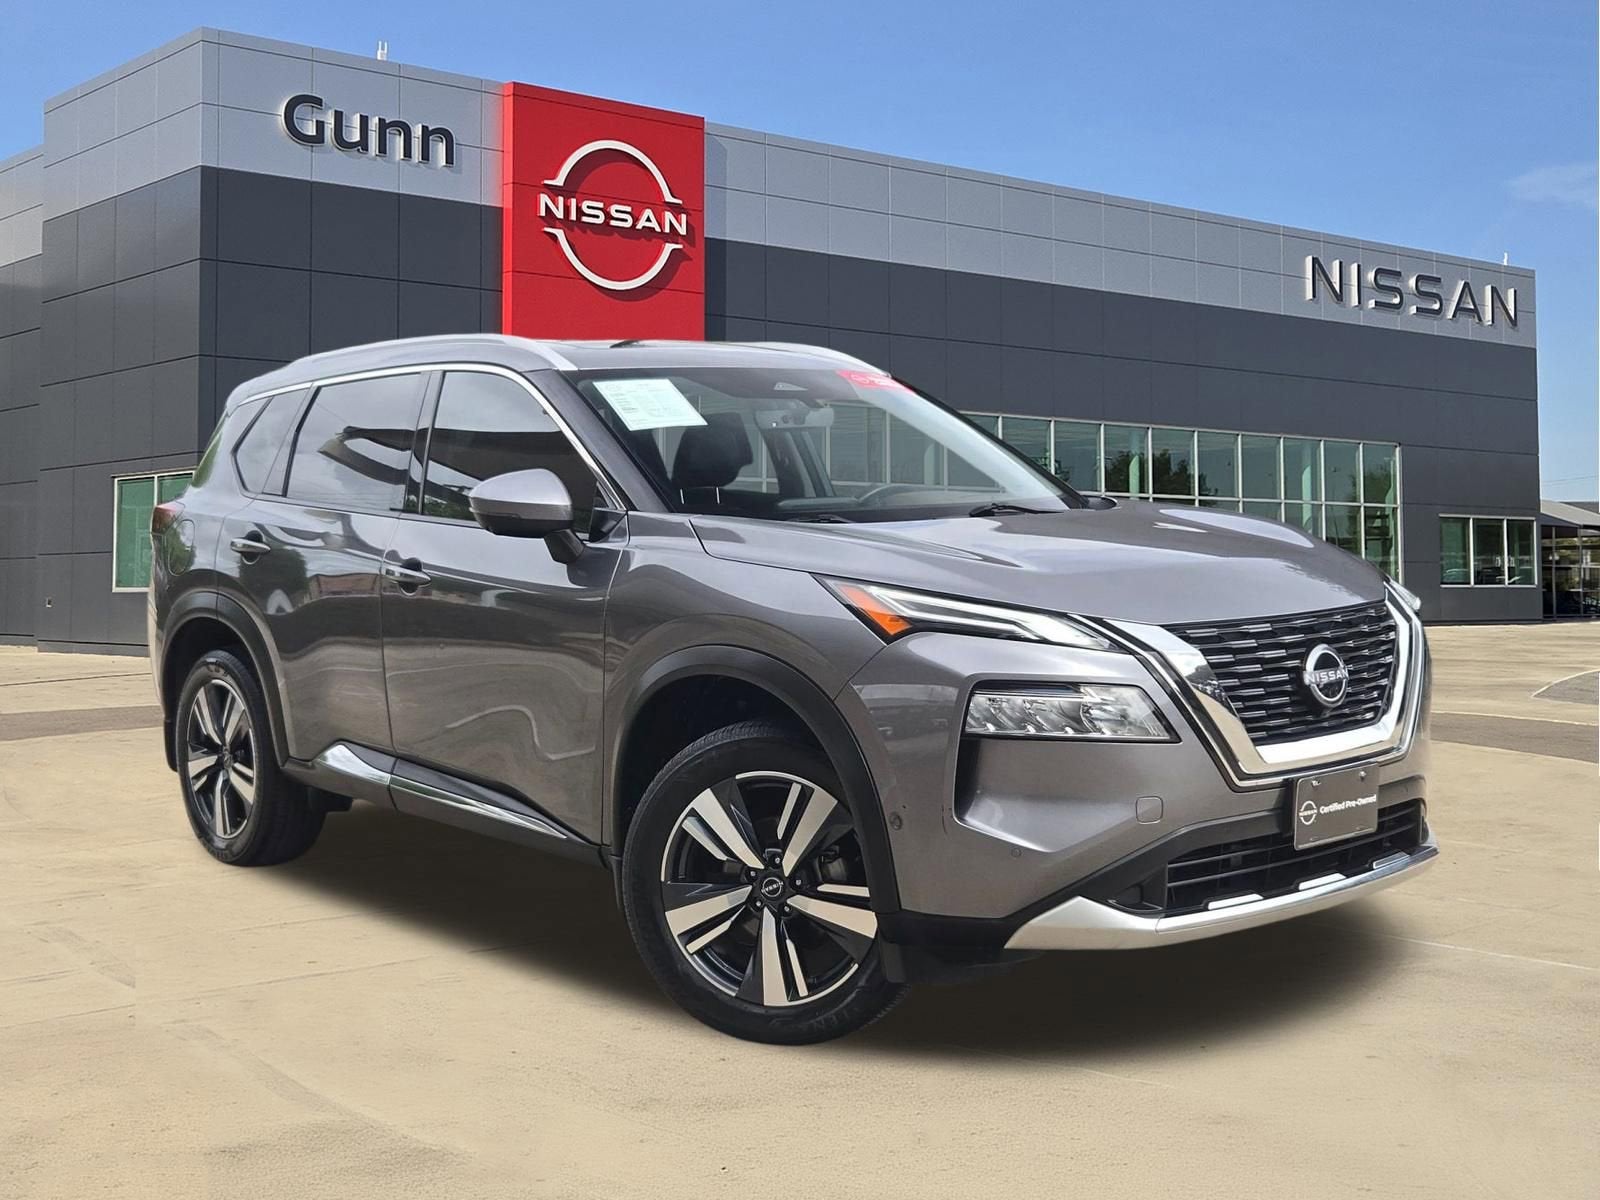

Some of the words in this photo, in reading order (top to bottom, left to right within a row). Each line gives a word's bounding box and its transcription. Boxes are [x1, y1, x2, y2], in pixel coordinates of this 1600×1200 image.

[283, 93, 455, 166] Gunn
[537, 193, 687, 236] NISSAN
[1305, 255, 1517, 328] NISSAN
[1304, 668, 1349, 686] NISSAN
[1319, 801, 1345, 814] Certified
[1345, 794, 1377, 808] Pre-Owned
